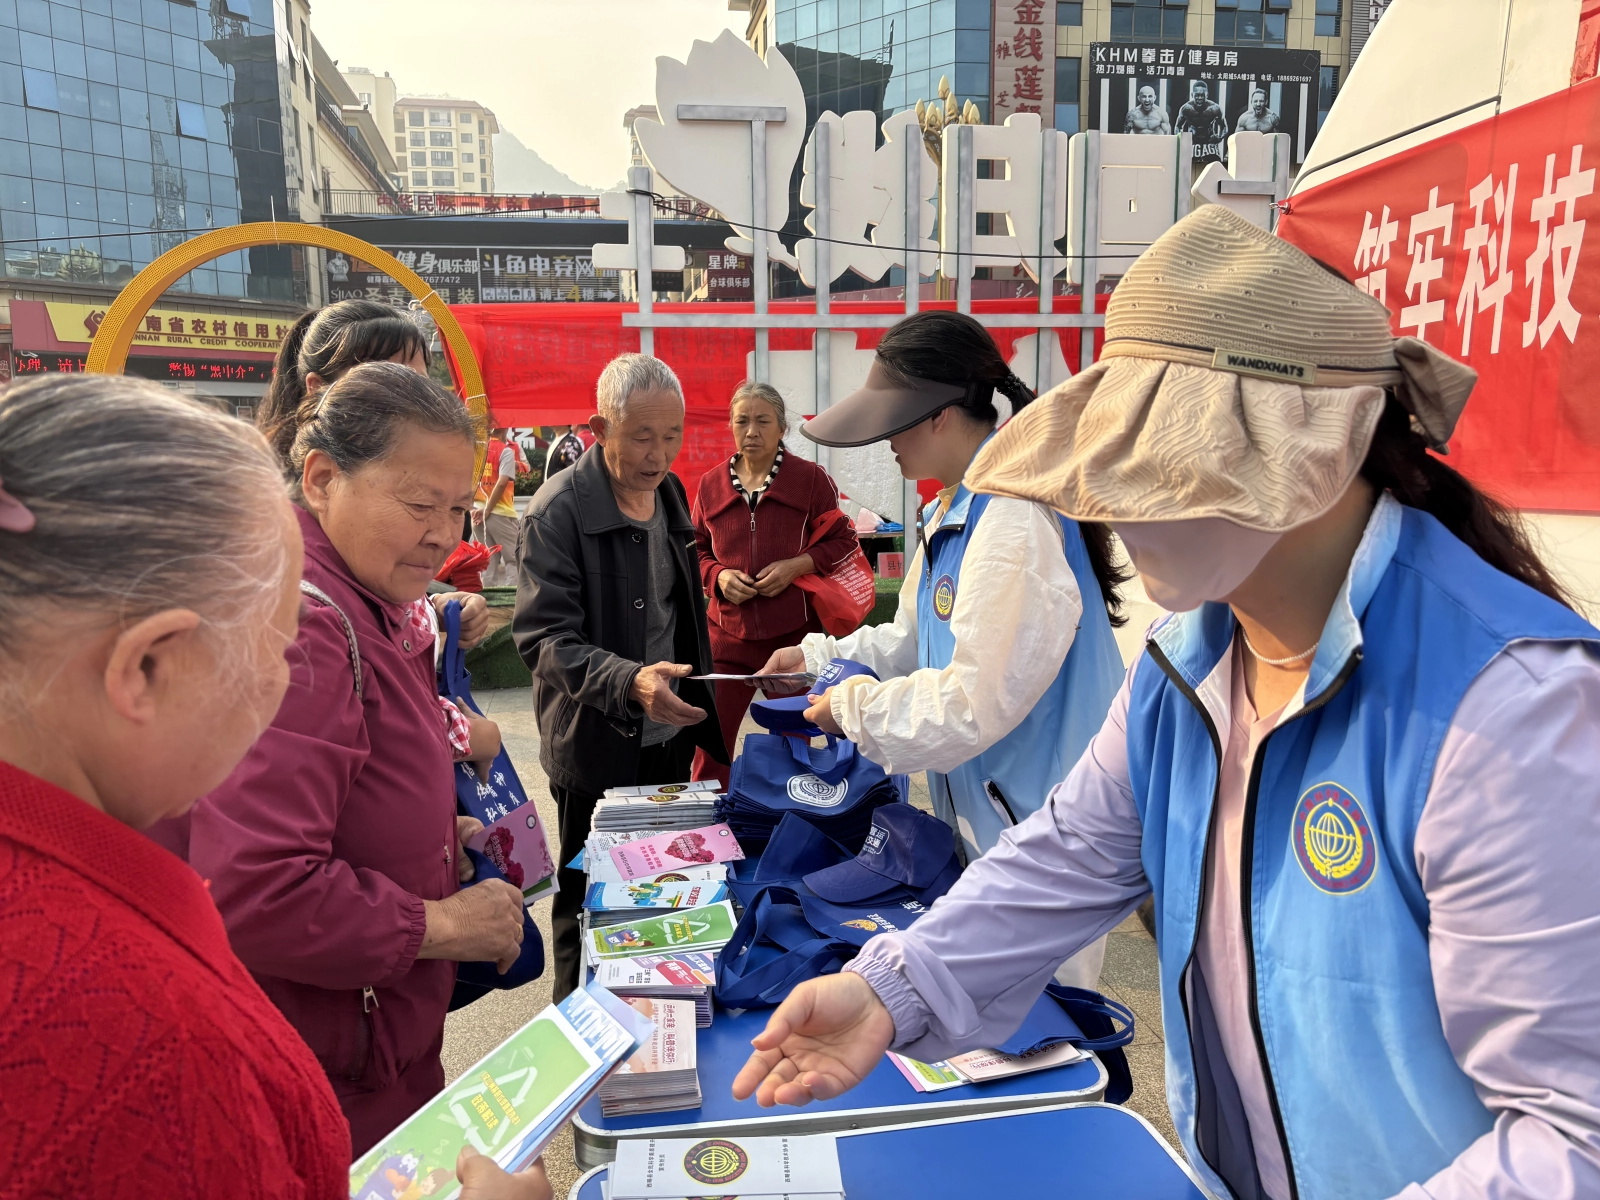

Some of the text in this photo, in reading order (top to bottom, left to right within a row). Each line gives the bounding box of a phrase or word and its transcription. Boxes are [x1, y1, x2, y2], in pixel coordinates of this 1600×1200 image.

[1013, 0, 1045, 113] 金线莲
[350, 250, 479, 274] 健身俱乐部
[708, 254, 738, 270] 星牌
[709, 277, 751, 288] 台球俱乐部
[167, 335, 194, 344] RURAL
[200, 338, 227, 346] CREDIT
[1227, 354, 1304, 378] WANDXHATS
